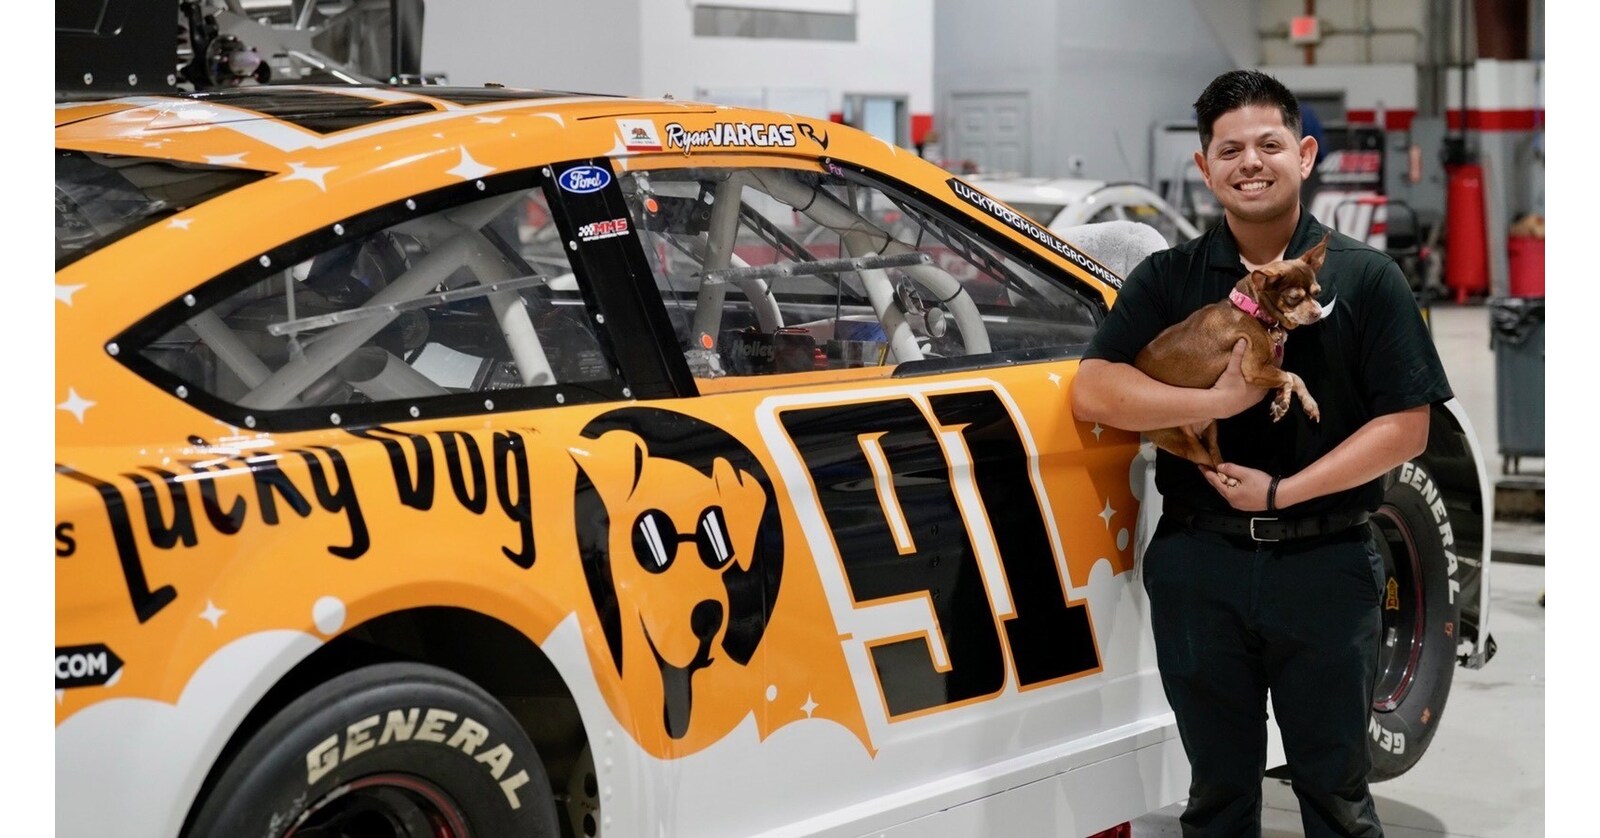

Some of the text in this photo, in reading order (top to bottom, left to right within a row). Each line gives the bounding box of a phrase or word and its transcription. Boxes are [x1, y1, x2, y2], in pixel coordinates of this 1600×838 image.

[706, 122, 797, 148] VARGAS
[569, 169, 603, 190] Ford
[731, 339, 776, 362] Holley
[777, 388, 1103, 722] 91
[1399, 461, 1460, 605] GENERAL
[305, 706, 530, 811] GENERAL
